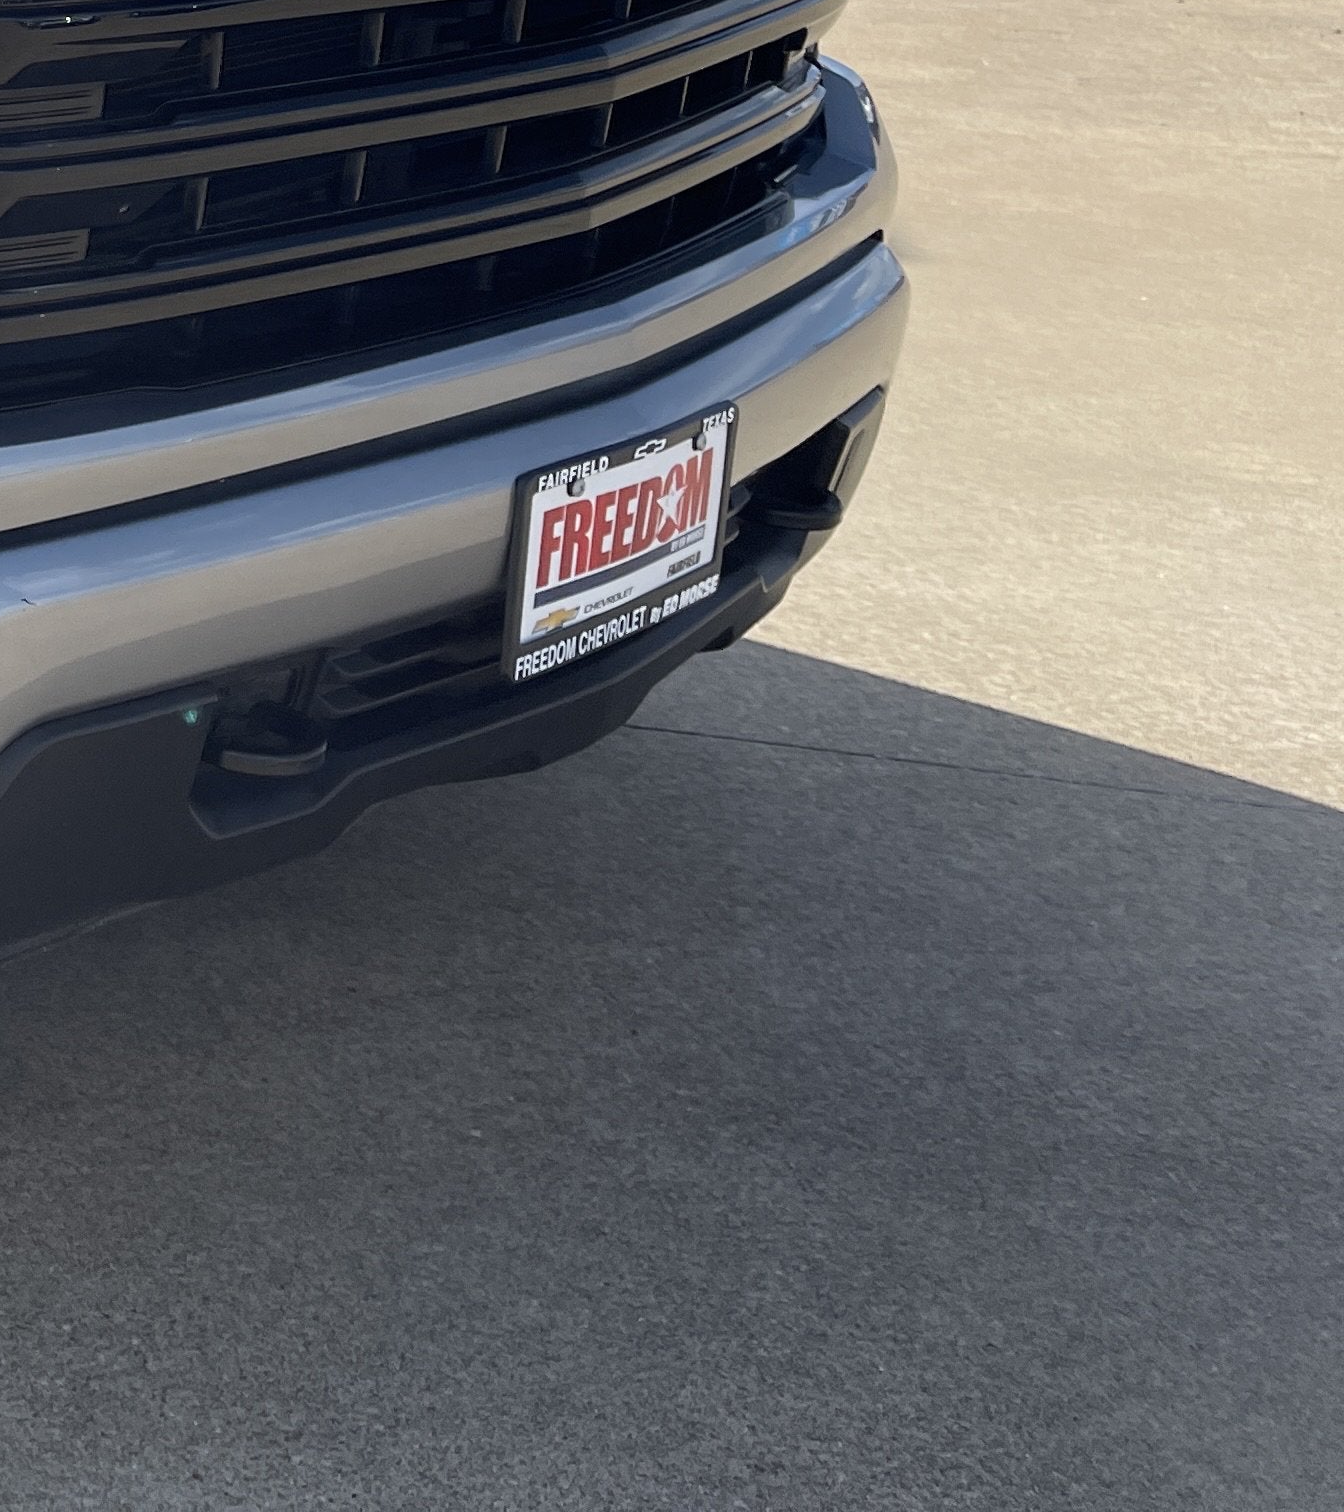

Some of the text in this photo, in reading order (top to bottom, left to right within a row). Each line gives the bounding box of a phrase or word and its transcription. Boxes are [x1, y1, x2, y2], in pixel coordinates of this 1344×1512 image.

[538, 407, 736, 493] FAIRFIELD TEXAS
[535, 447, 714, 589] FREEDOM
[514, 635, 577, 682] FREEDOM
[578, 605, 648, 656] CHEVROLET
[662, 593, 680, 619] ED
[678, 574, 720, 610] MORSE
